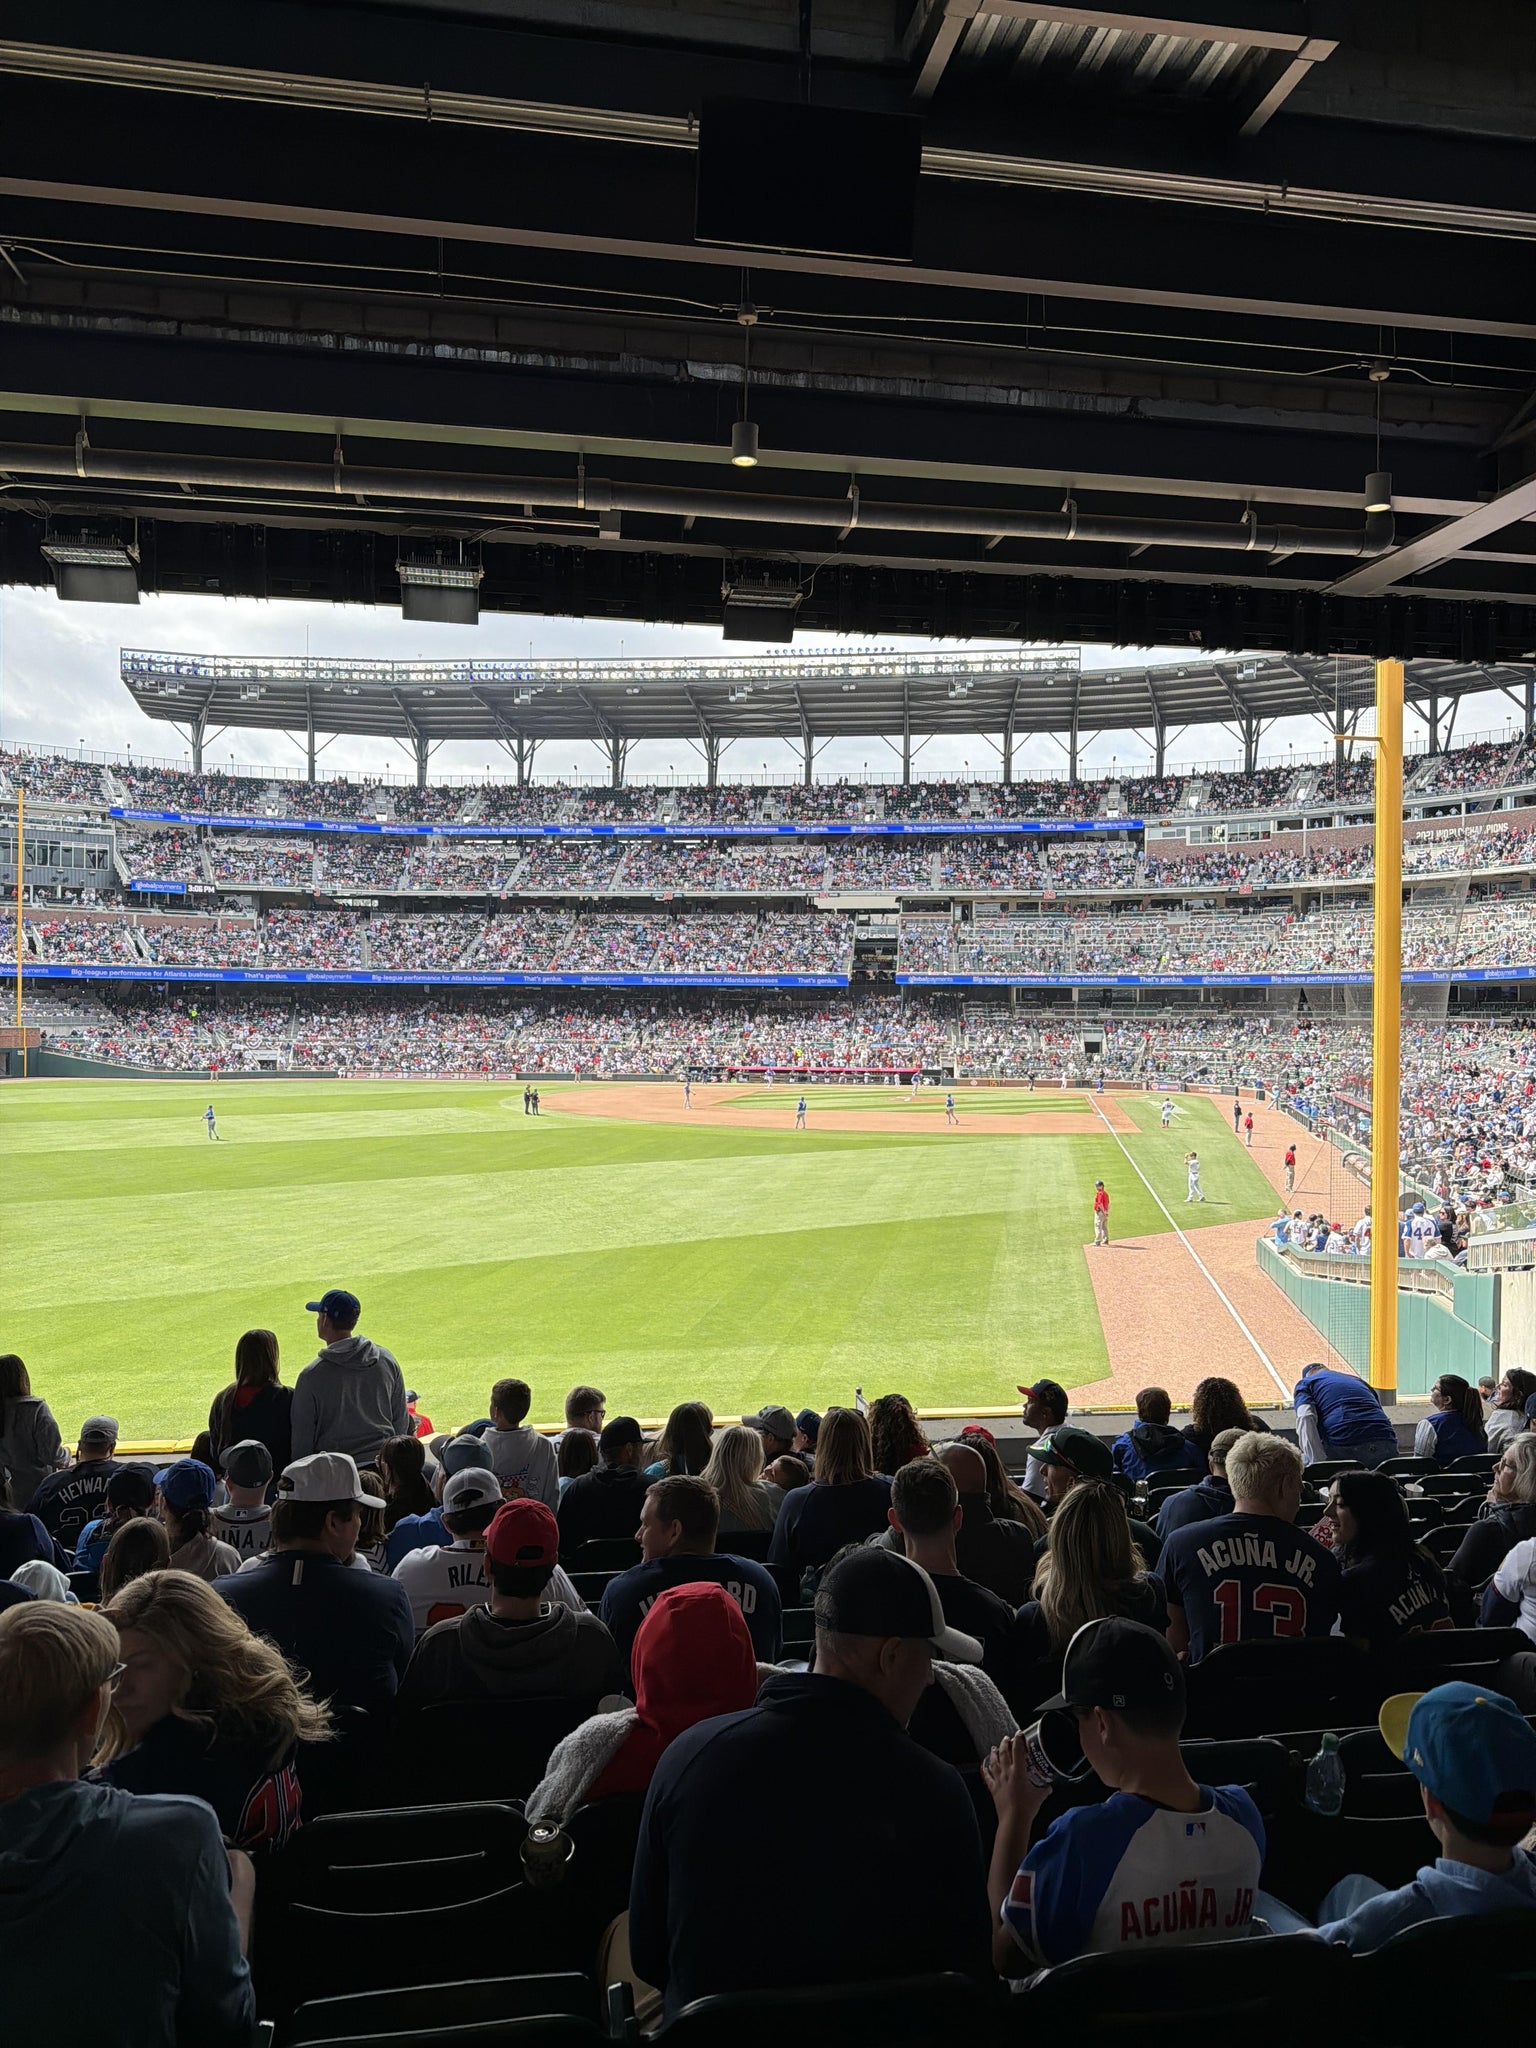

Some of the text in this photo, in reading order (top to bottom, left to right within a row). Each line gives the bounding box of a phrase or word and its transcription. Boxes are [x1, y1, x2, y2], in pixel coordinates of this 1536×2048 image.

[180, 815, 210, 824] Big-league
[210, 817, 245, 826] performance
[275, 820, 305, 828] businesses
[433, 826, 460, 834] Big-league
[71, 968, 107, 977] Big-league
[109, 969, 152, 978] performance
[372, 974, 402, 983] Big-league
[403, 975, 442, 984] performance
[642, 976, 674, 985] Big-league
[674, 977, 714, 985] performance
[973, 977, 1006, 985] Big-league
[1006, 977, 1047, 985] performance
[1271, 975, 1306, 984] Big-league
[1349, 974, 1358, 982] for
[1413, 1227, 1432, 1240] 44
[1197, 1532, 1317, 1588] ACUÑA JR.
[1214, 1579, 1307, 1645] 13
[1120, 1880, 1217, 1942] ACUÑA
